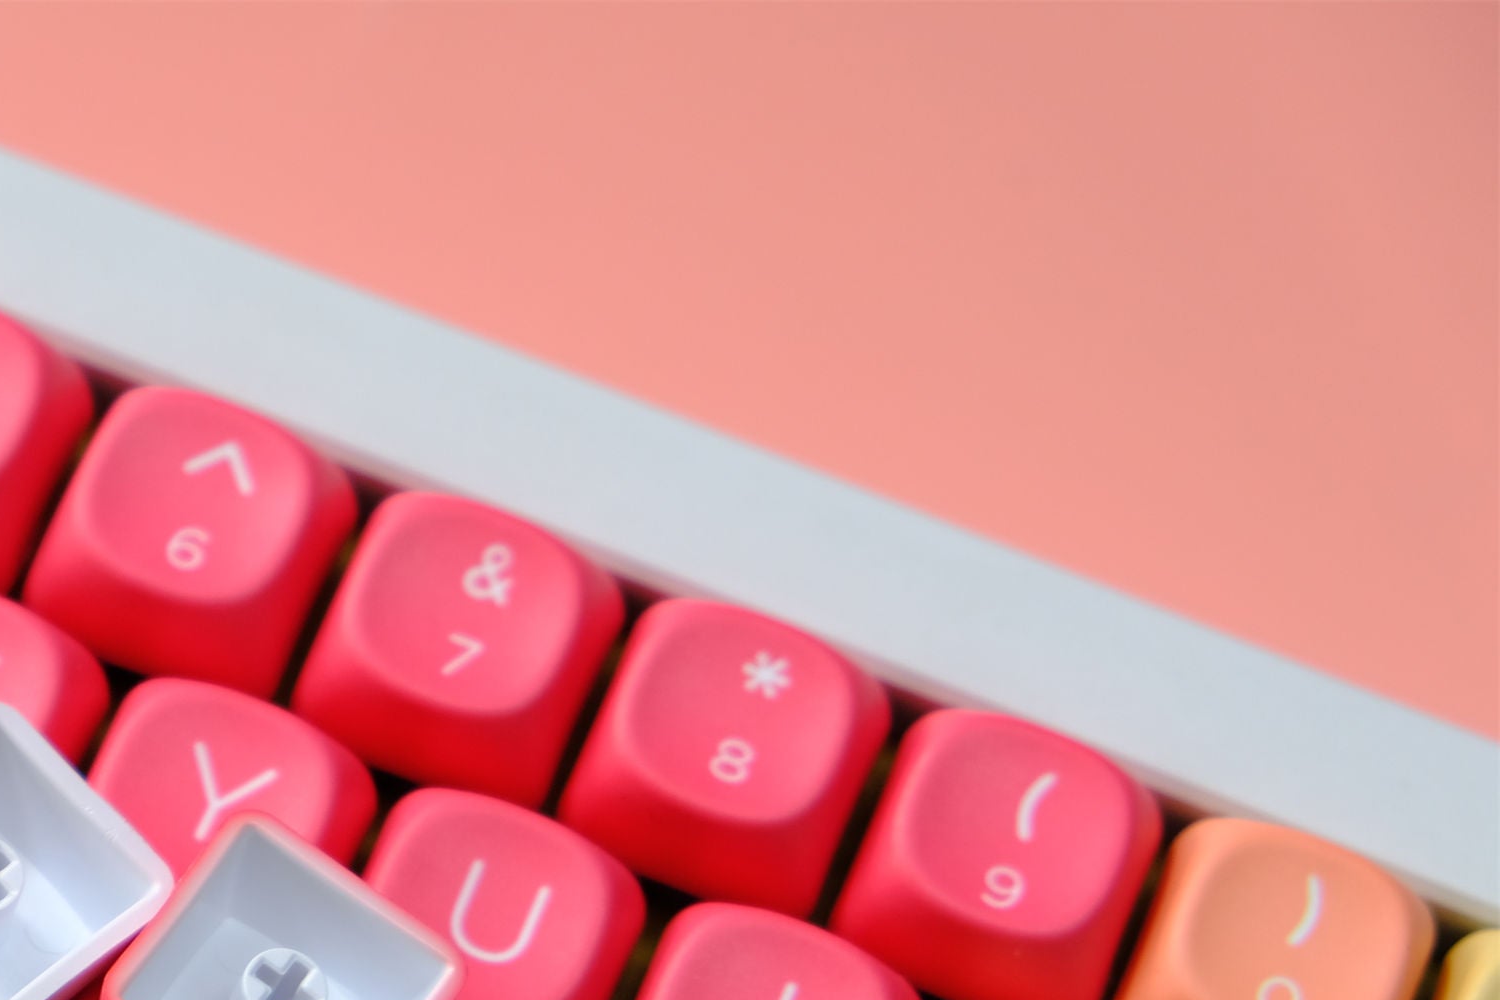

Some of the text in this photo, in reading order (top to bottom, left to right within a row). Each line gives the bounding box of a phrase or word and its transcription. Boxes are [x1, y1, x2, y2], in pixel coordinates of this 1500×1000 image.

[165, 528, 210, 572] 6
[462, 544, 512, 605] &
[442, 633, 484, 675] 7
[709, 739, 754, 784] 8
[193, 741, 278, 842] Y
[982, 866, 1023, 908] 9
[449, 858, 551, 964] U
